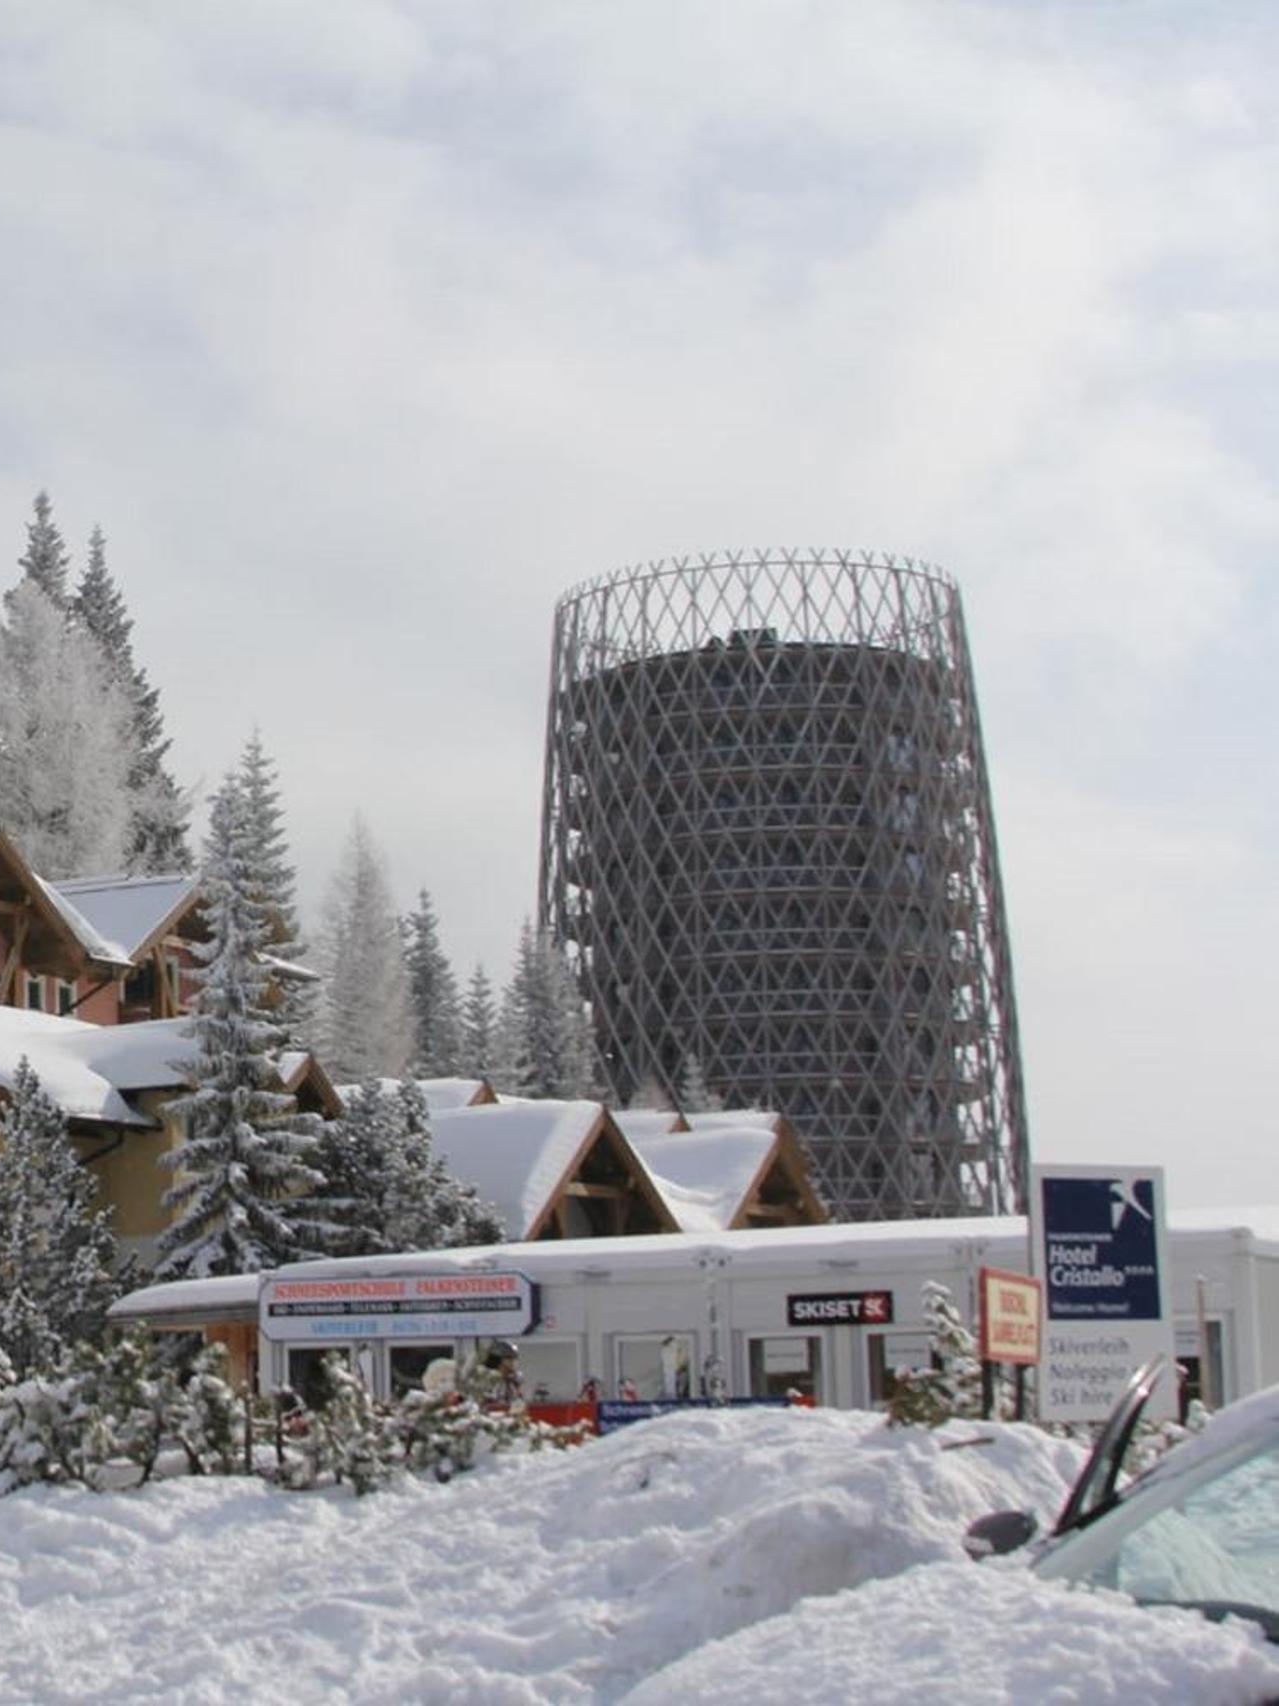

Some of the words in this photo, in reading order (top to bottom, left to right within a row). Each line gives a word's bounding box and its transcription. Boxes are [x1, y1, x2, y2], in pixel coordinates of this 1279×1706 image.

[1049, 1244, 1097, 1265] Hotel
[1050, 1265, 1125, 1287] Cristallo
[793, 1300, 861, 1318] SKISET
[1049, 1338, 1130, 1355] Skiverleih
[1050, 1364, 1127, 1384] Noleggio
[1050, 1388, 1075, 1406] Ski
